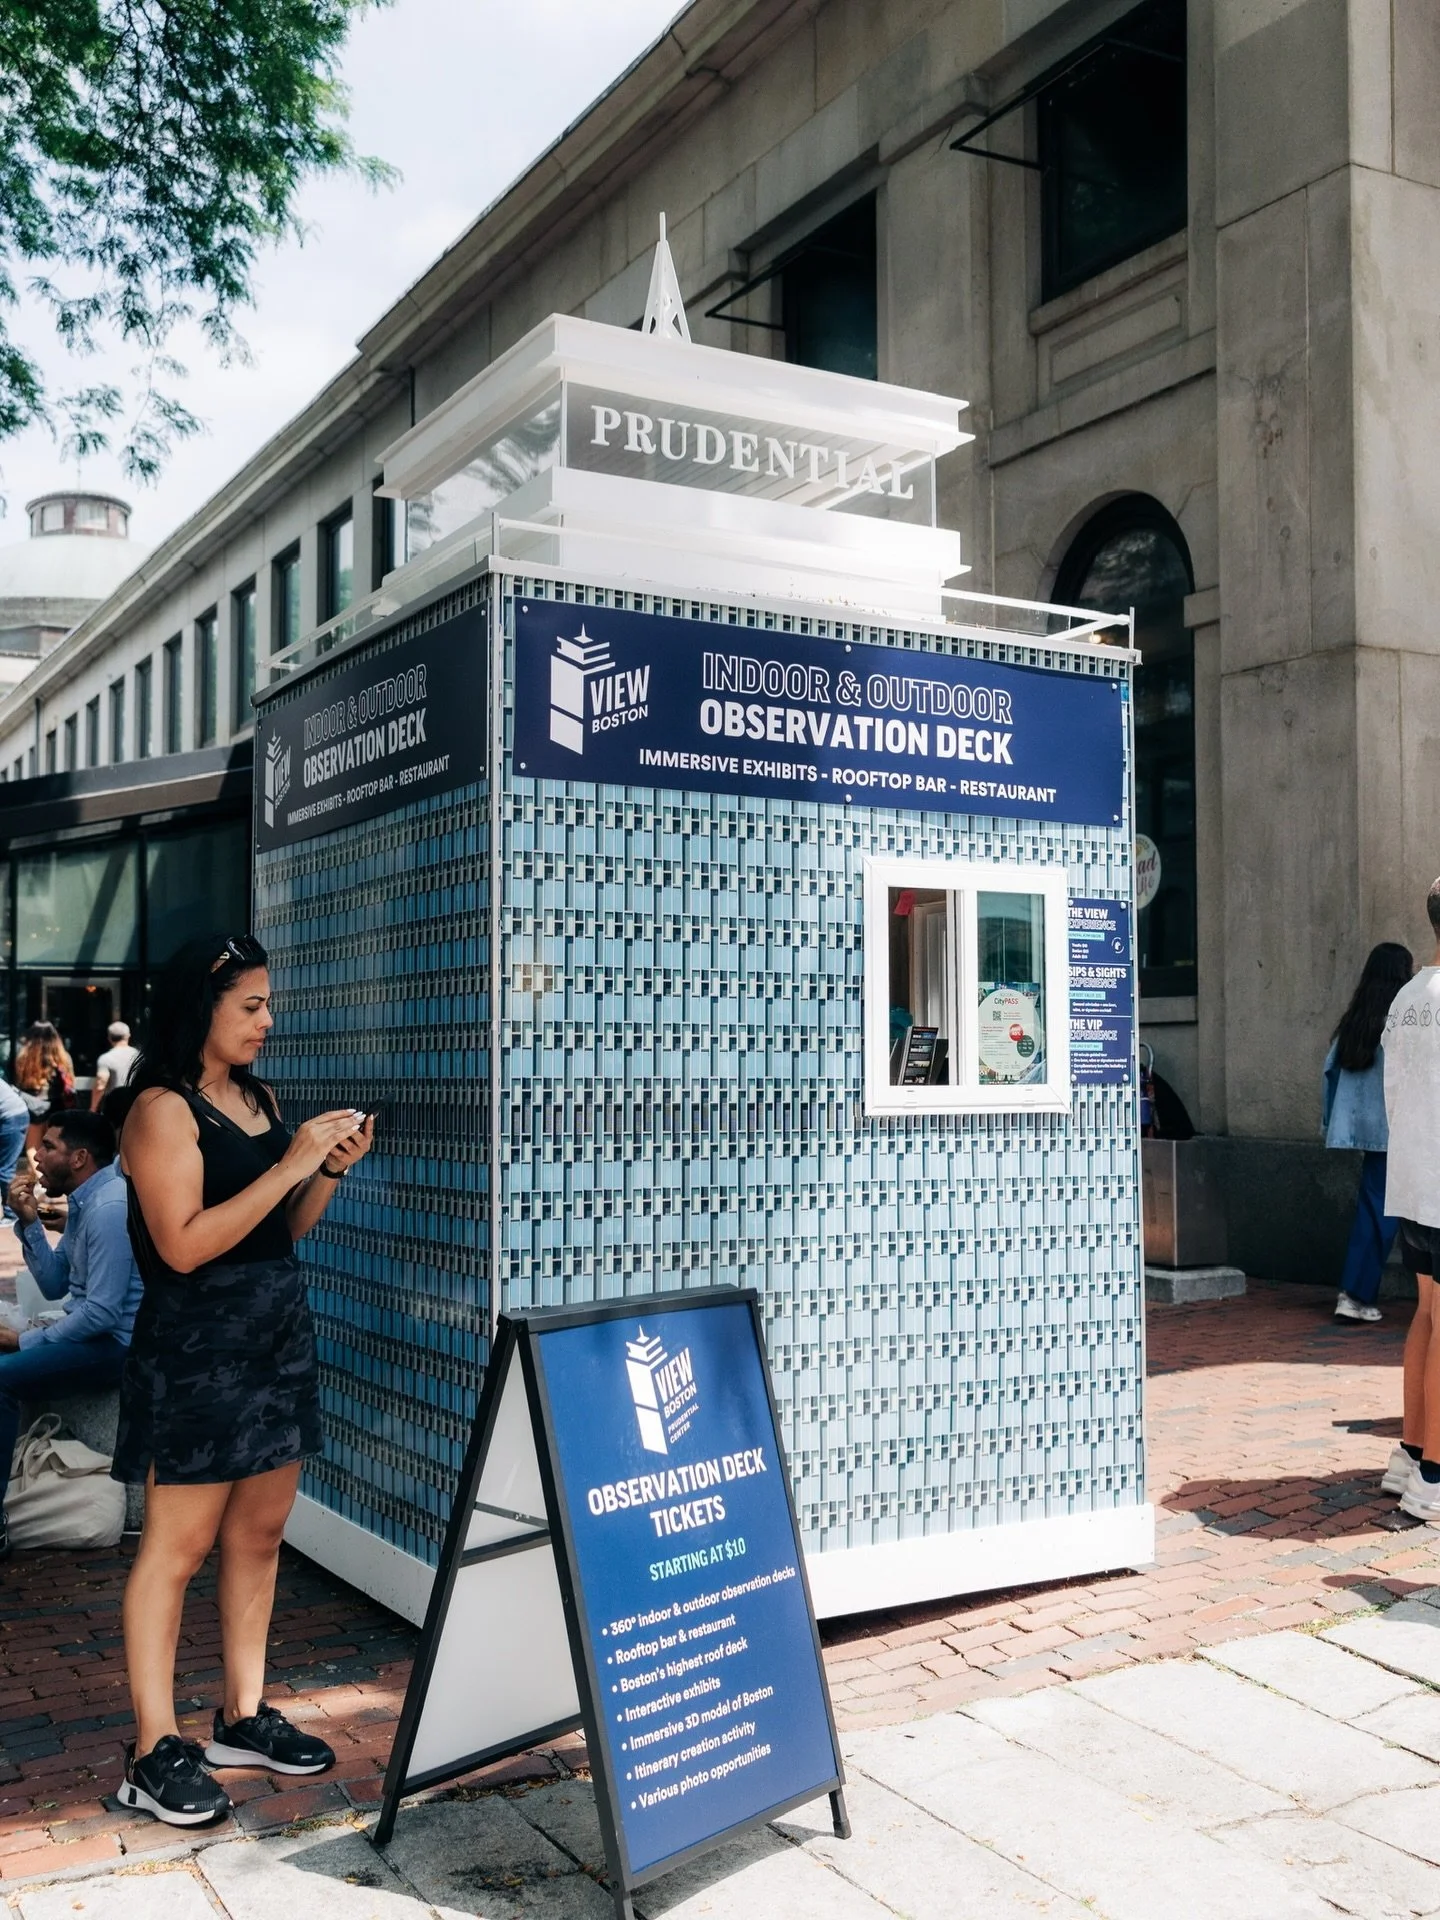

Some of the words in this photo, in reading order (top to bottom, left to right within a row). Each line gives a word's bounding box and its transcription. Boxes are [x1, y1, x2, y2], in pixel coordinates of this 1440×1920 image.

[590, 405, 914, 500] PRUDENTIAL
[304, 701, 346, 750] INDOOR
[348, 695, 358, 730] &
[358, 663, 427, 725] OUTDOOR
[591, 665, 650, 716] VIEW
[703, 652, 830, 704] INDOOR
[836, 670, 862, 707] &
[867, 674, 1014, 725] OUTDOOR
[592, 705, 648, 733] BOSTON
[700, 698, 928, 756] OBSERVATION
[936, 725, 1014, 765] DECK
[275, 745, 291, 796] VIEW
[303, 724, 385, 788] OBSERVATION
[388, 708, 427, 754] DECK
[287, 803, 317, 826] IMMERSIVE
[317, 793, 342, 814] EXHIBITS
[346, 780, 378, 804] ROOFTOP
[379, 774, 394, 794] BAR
[399, 754, 450, 787] RESTAURANT
[639, 749, 739, 774] IMMERSIVE
[743, 759, 818, 782] EXHIBITS
[832, 768, 912, 790] ROOFTOP
[916, 775, 946, 793] BAR
[960, 780, 1057, 803] RESTAURANT
[1068, 907, 1083, 918] THE
[1084, 908, 1108, 919] VIEW
[1068, 966, 1087, 977] SIPS
[1088, 967, 1095, 977] &
[1095, 967, 1127, 979] SIGHTS
[994, 997, 1019, 1006] CityPASS
[1069, 1019, 1086, 1030] THE
[1086, 1019, 1103, 1030] VIP
[655, 1347, 693, 1404] VIEW
[664, 1381, 697, 1419] BOSTON
[668, 1402, 699, 1435] PRUDENTIAL
[670, 1421, 691, 1444] CENTER
[587, 1459, 721, 1516] OBSERVATION
[723, 1447, 767, 1482] DECK
[650, 1495, 726, 1538] TICKETS
[649, 1550, 709, 1581] STARTING
[710, 1545, 724, 1565] AT
[725, 1537, 746, 1561] $10
[638, 1608, 672, 1628] indoor
[673, 1604, 682, 1617] &
[683, 1592, 720, 1613] outdoor
[721, 1575, 772, 1600] observation
[772, 1565, 796, 1583] decks
[615, 1641, 659, 1665] Rooftop
[660, 1630, 678, 1648] bar
[679, 1629, 687, 1642] &
[688, 1614, 736, 1640] restaurant
[620, 1667, 666, 1693] Boston's
[667, 1651, 704, 1677] highest
[704, 1646, 724, 1664] roof
[725, 1637, 748, 1655] deck
[625, 1692, 682, 1722] Interactive
[683, 1676, 721, 1700] exhibits
[630, 1722, 684, 1750] Immersive
[685, 1712, 700, 1730] 3D
[701, 1699, 731, 1723] model
[732, 1696, 742, 1711] of
[743, 1685, 774, 1705] Boston
[635, 1751, 679, 1780] Itinerary
[681, 1736, 721, 1762] creation
[722, 1719, 756, 1744] activity
[638, 1782, 679, 1809] Various
[680, 1769, 710, 1796] photo
[711, 1742, 772, 1780] opportunities
